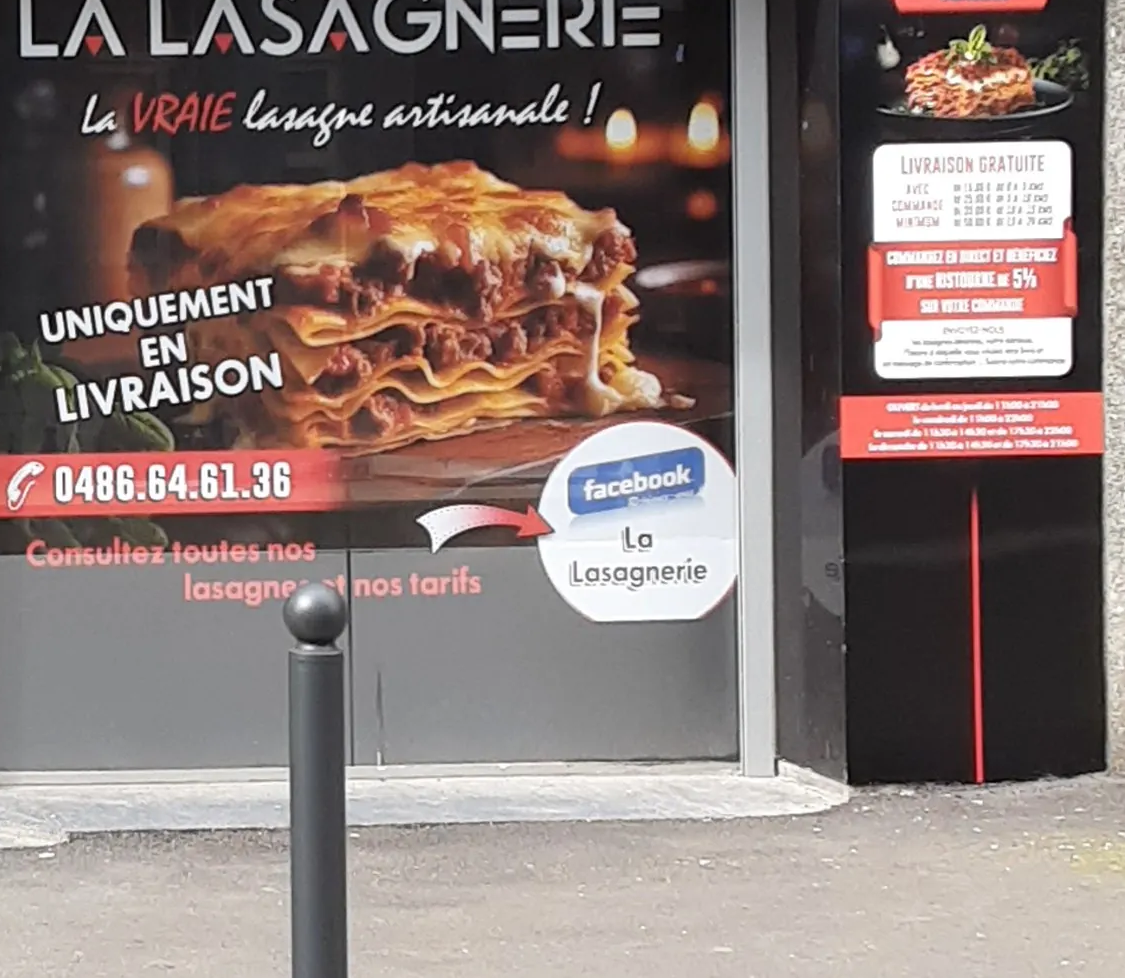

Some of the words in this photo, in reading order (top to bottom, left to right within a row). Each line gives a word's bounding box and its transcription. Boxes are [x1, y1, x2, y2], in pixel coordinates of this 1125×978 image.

[81, 89, 116, 135] La
[133, 89, 237, 139] VRAIE
[242, 86, 373, 149] lasagne
[383, 83, 569, 135] artisanale
[583, 82, 602, 129] !
[900, 155, 974, 174] LIVRAISON
[979, 154, 1045, 173] GRATUITE
[1012, 267, 1037, 289] 5%
[39, 277, 275, 344] UNIQUEMENT
[140, 332, 187, 368] EN
[55, 352, 284, 423] LIVRAISON
[54, 461, 291, 503] 0486.64.61.36
[582, 463, 691, 502] facebook
[26, 537, 165, 567] Consultez
[172, 540, 261, 565] toutes
[267, 540, 316, 563] nos
[622, 526, 653, 554] La
[184, 573, 310, 606] lasagne
[354, 575, 404, 598] nos
[409, 565, 483, 596] tarifs
[569, 557, 708, 592] Lasagnerie
